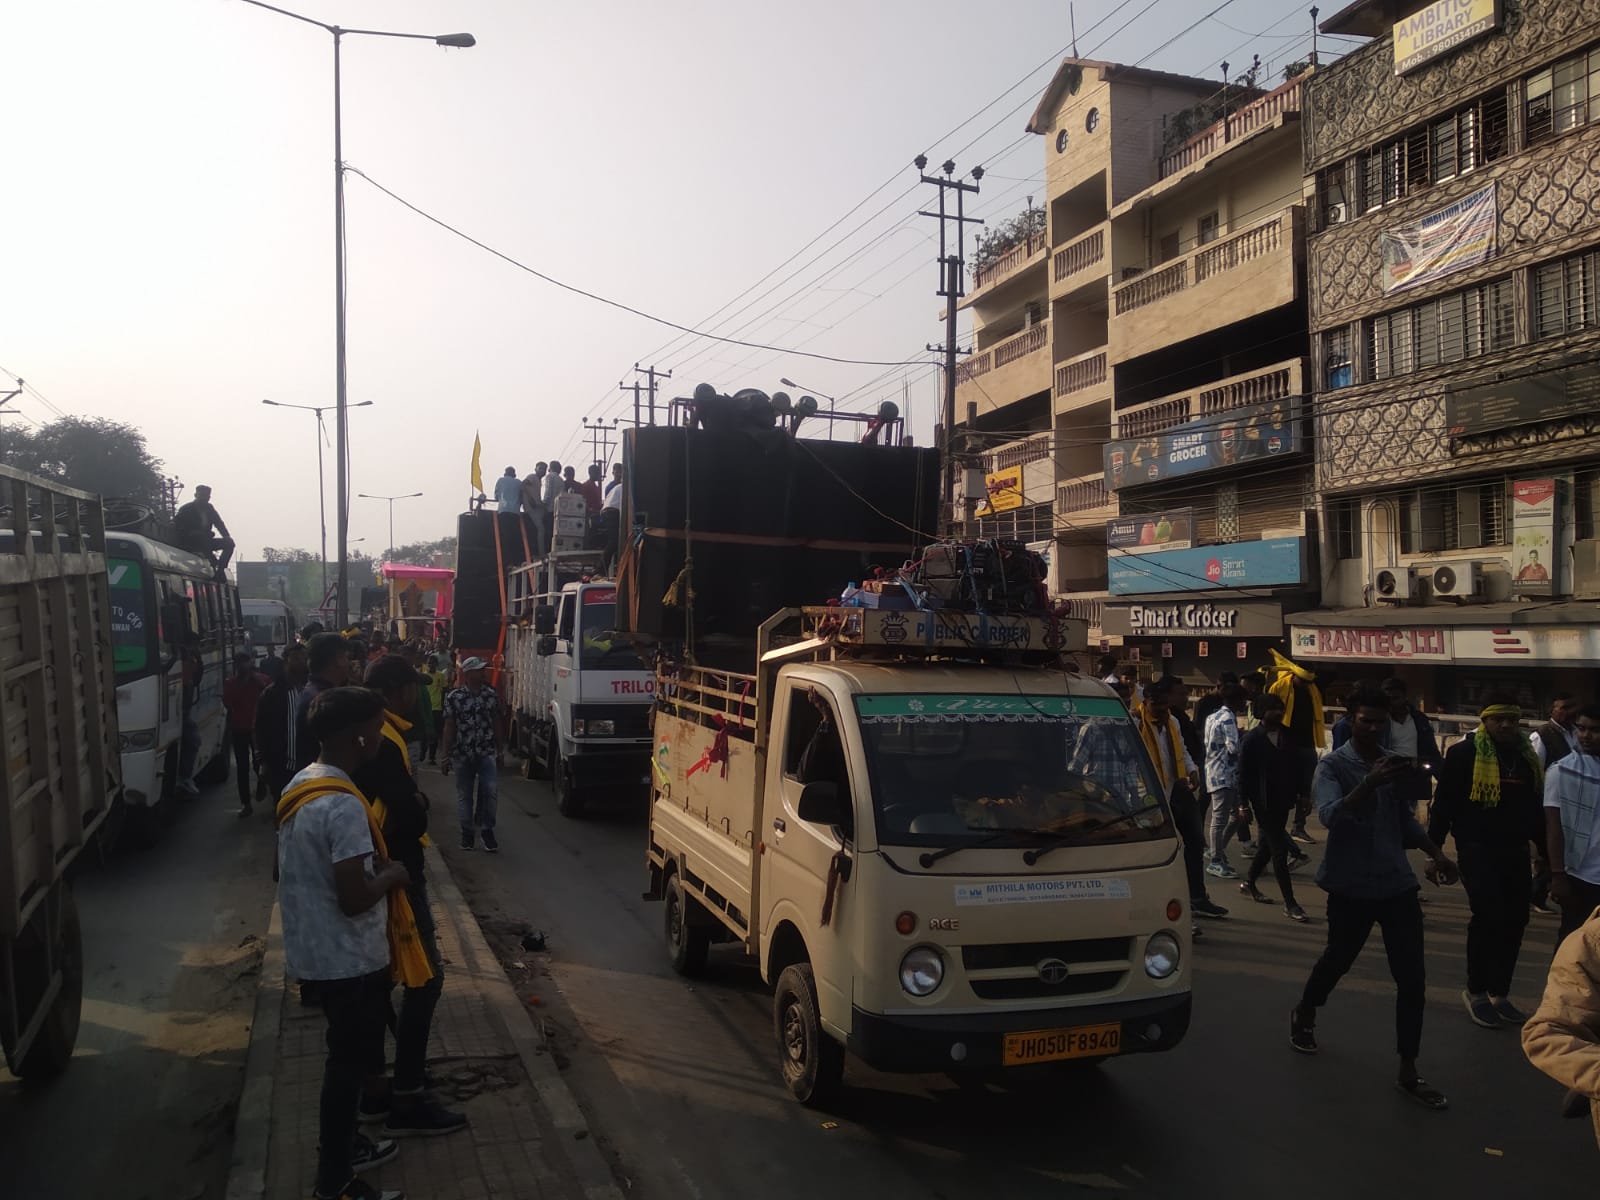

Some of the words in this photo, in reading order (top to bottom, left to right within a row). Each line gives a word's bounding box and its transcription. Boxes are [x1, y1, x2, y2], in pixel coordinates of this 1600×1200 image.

[1397, 0, 1480, 42] AMBITI
[1412, 7, 1473, 50] LIBRARY
[1432, 20, 1486, 55] 9801334122
[1172, 432, 1204, 450] SMART
[1169, 444, 1208, 463] GROCER
[1111, 523, 1136, 537] Amul
[1207, 563, 1221, 576] Jio
[1222, 559, 1245, 569] Smart
[1130, 605, 1180, 627] Smart
[916, 622, 968, 640] PBLIC
[971, 624, 1030, 643] CRRIER
[1318, 629, 1404, 653] RANTEC
[611, 681, 658, 694] TRILO
[986, 883, 1025, 893] MITHILA
[1027, 881, 1065, 891] MOTORS
[1066, 880, 1085, 889] PVT.
[1086, 880, 1104, 888] LTD.
[929, 918, 960, 930] ACE
[1015, 1029, 1119, 1059] JH05DF8940
